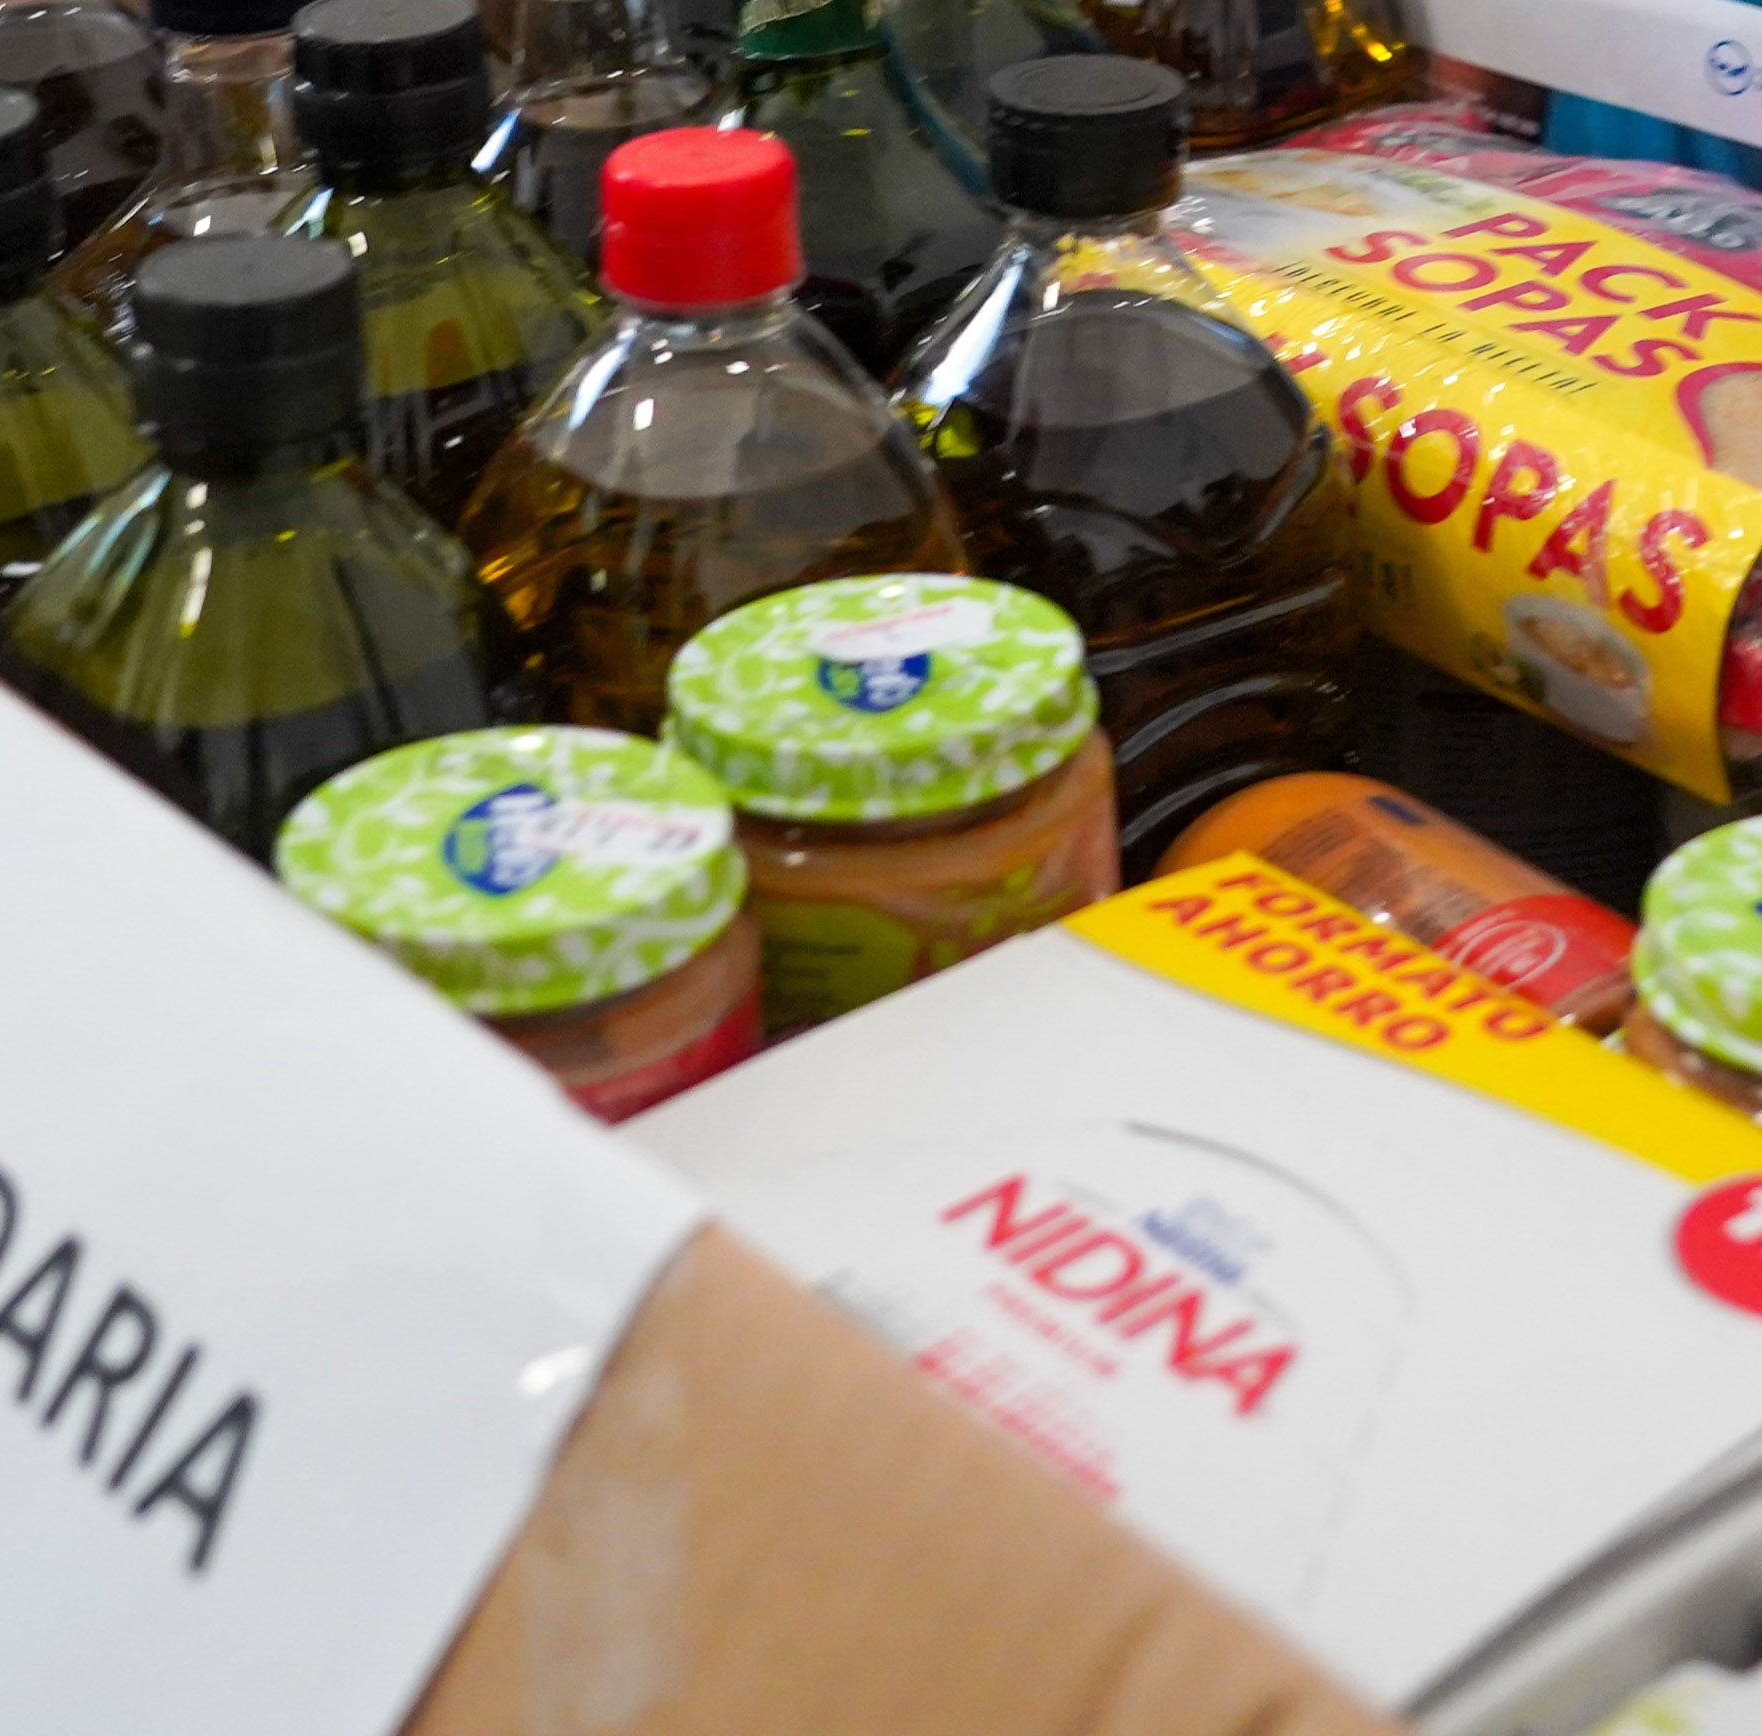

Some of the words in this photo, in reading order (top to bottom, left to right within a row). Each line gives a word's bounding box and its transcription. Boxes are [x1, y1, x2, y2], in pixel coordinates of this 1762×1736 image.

[1324, 229, 1704, 378] SOPAS
[1334, 374, 1715, 635] SOPAS
[1146, 892, 1451, 1053] AHORRO
[1215, 870, 1549, 1042] FORMATO
[939, 1172, 1301, 1420] NIDINA
